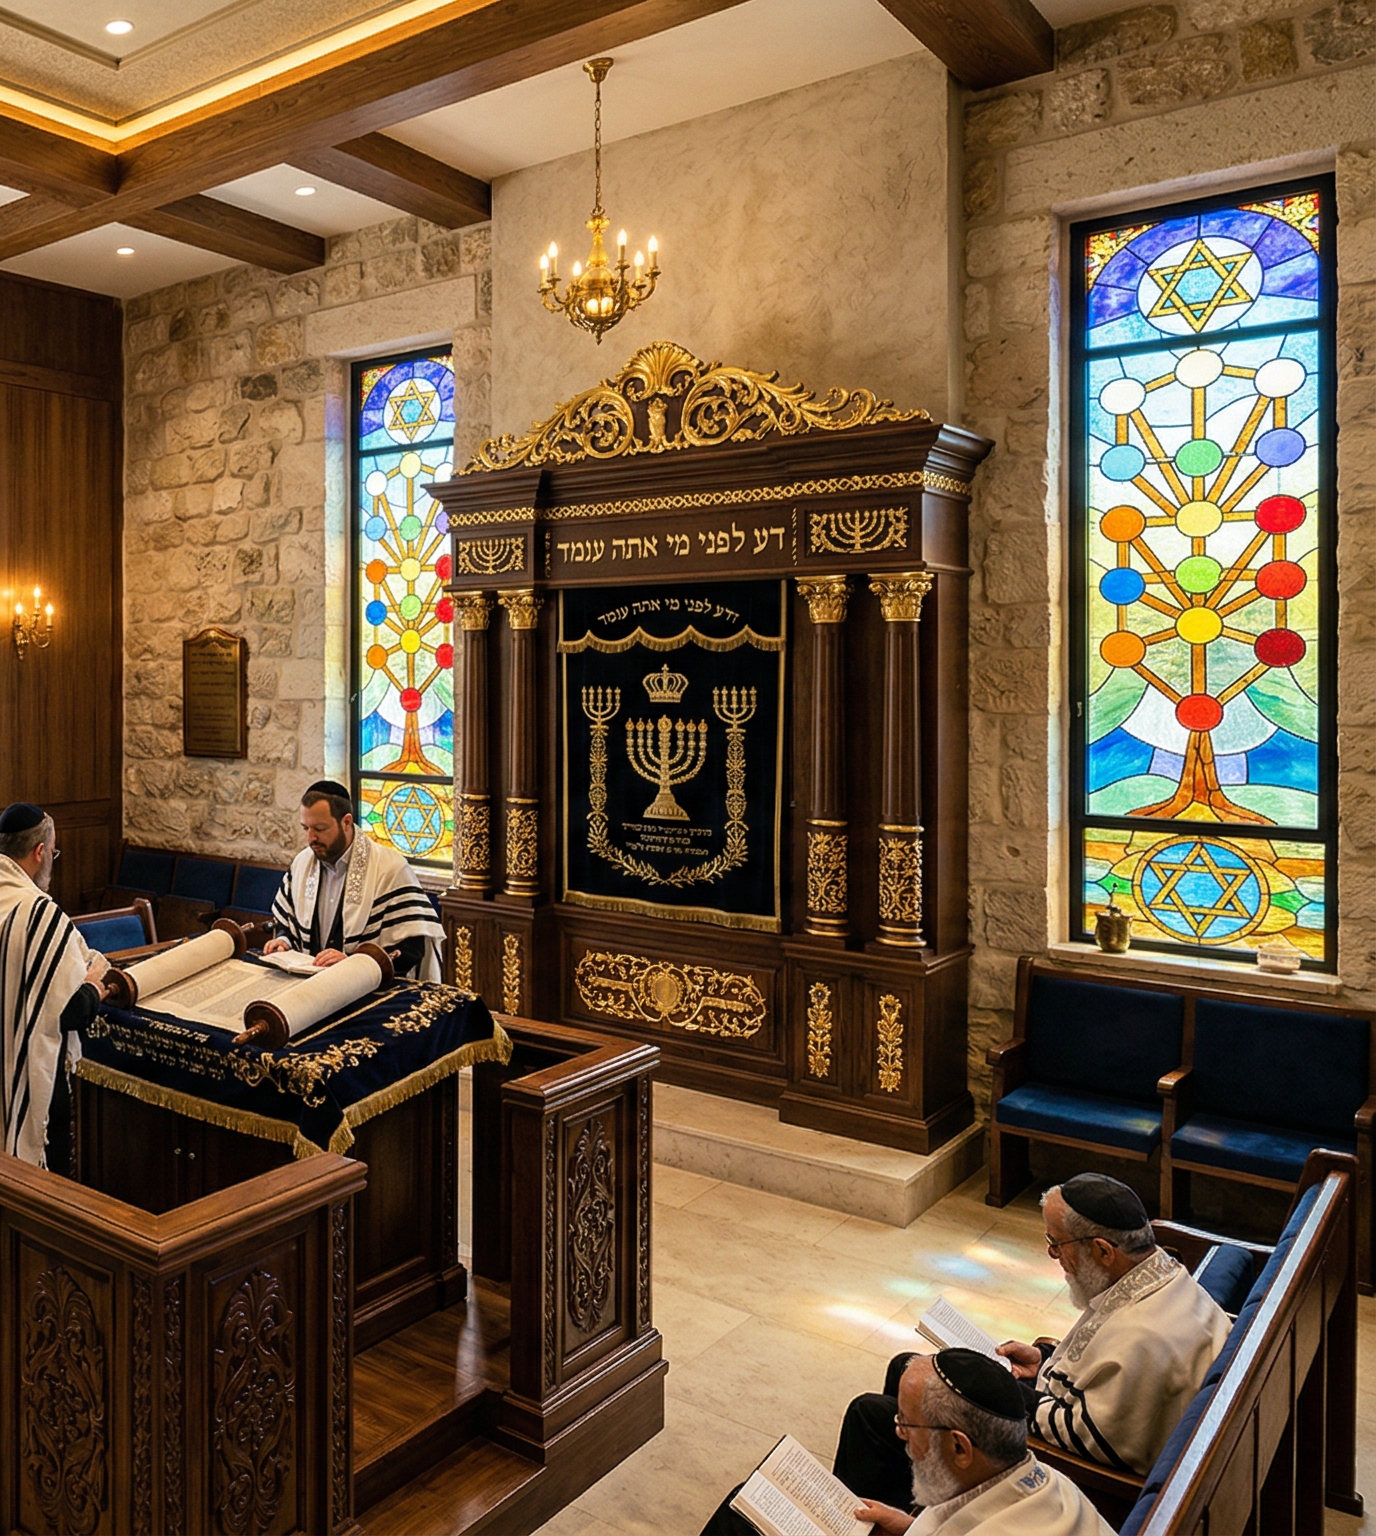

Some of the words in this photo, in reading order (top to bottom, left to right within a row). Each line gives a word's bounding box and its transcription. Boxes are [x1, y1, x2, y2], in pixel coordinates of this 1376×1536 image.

[612, 534, 658, 560] אתה
[666, 533, 690, 556] מי
[698, 522, 745, 554] לפני
[753, 527, 785, 555] דע
[631, 598, 661, 616] אתה
[664, 598, 680, 611] מי
[684, 598, 712, 614] לפני
